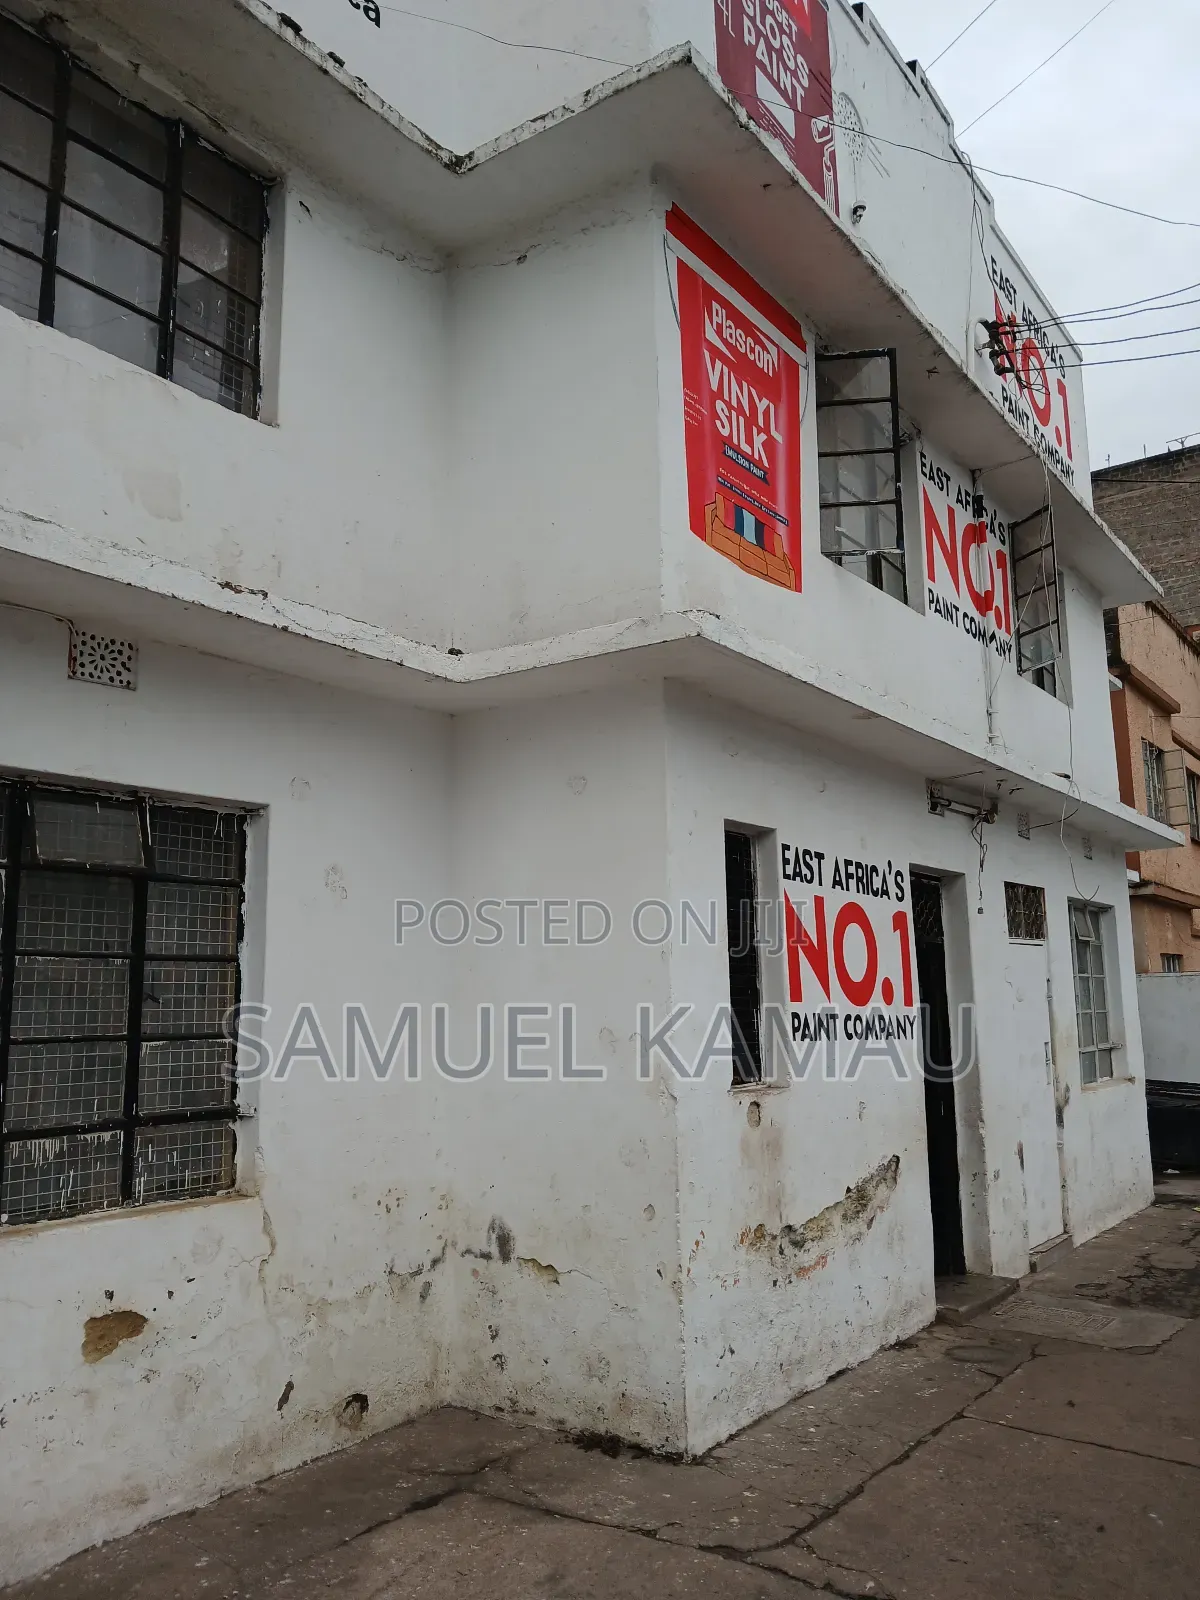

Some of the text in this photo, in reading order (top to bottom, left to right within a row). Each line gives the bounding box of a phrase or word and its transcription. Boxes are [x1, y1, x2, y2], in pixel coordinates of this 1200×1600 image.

[743, 14, 805, 112] PAINT
[991, 254, 1018, 313] EAST
[711, 299, 774, 378] Plascon
[704, 349, 784, 445] VINYL
[1001, 383, 1030, 436] PAINT
[715, 399, 771, 469] SILK
[919, 450, 950, 497] EAST
[922, 483, 1012, 637] NO.1
[928, 586, 960, 628] PAINT
[780, 842, 905, 903] EAST AFRICA'S
[783, 886, 914, 1008] NO.1
[791, 1011, 918, 1042] PAINT COMPANY
